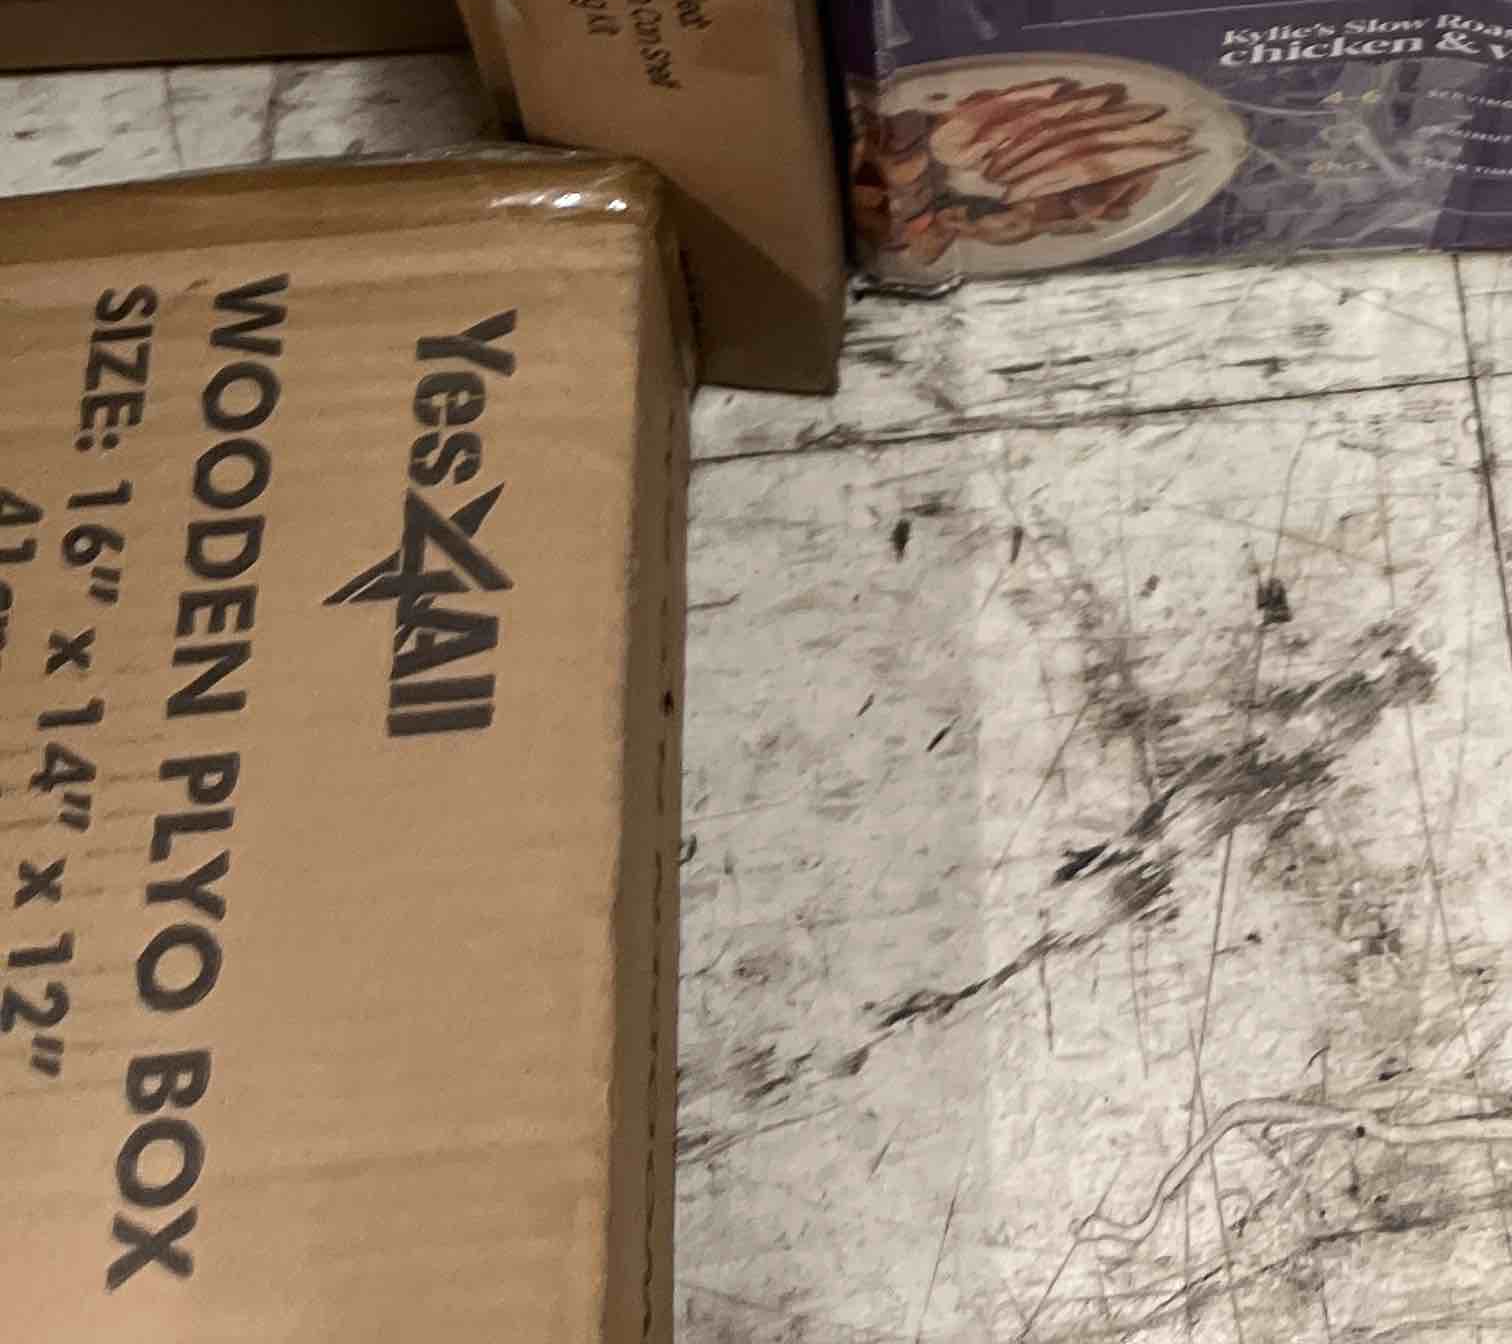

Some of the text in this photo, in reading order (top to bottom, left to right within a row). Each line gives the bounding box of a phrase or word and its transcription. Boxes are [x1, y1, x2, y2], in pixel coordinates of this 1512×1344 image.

[1218, 35, 1424, 65] chicken
[1434, 30, 1481, 54] &
[1220, 22, 1337, 47] Kylie's
[1342, 16, 1433, 34] Slow
[74, 284, 159, 452] SIZE:
[61, 478, 133, 607] 16"
[45, 625, 97, 675] x
[29, 695, 105, 832] 14"
[103, 272, 290, 1295] WOODEN PLYO BOX
[13, 855, 68, 910] x
